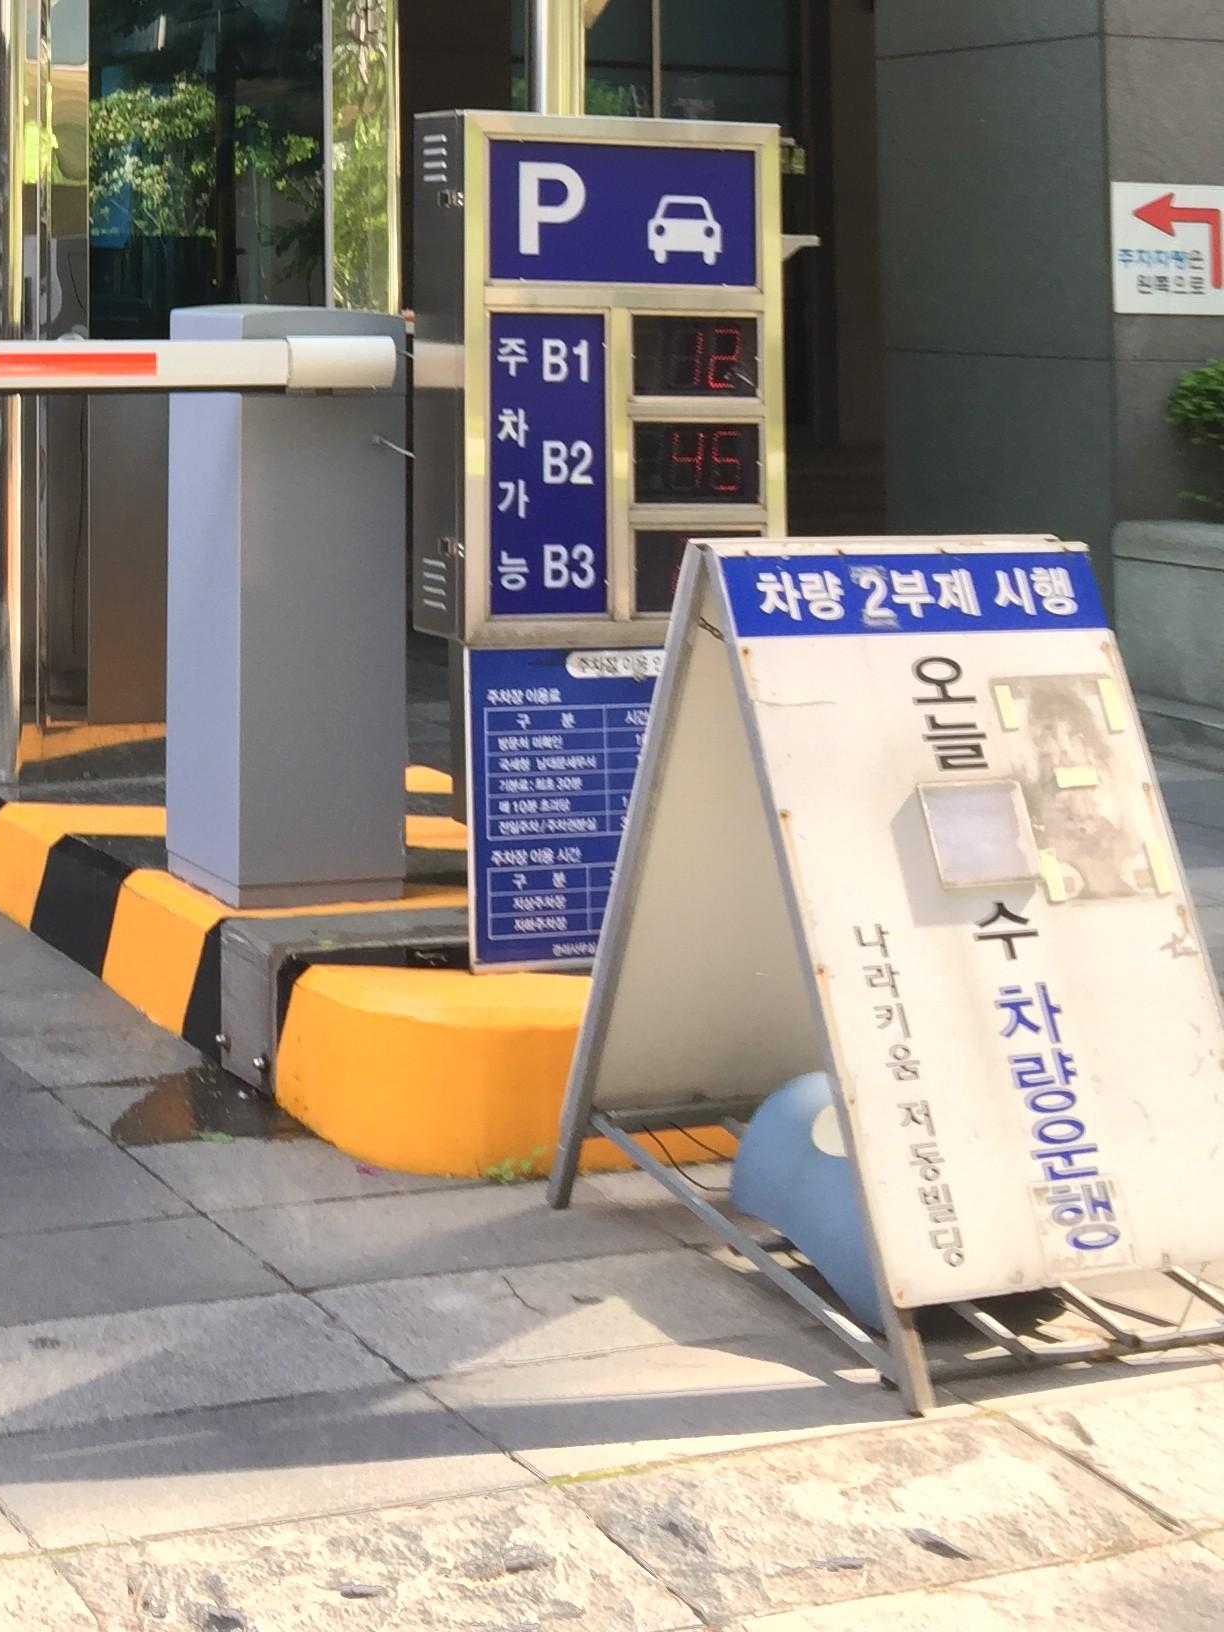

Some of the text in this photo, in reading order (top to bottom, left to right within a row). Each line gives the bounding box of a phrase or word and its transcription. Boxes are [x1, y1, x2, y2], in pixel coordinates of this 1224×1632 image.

[518, 161, 587, 256] P
[542, 338, 591, 384] B1
[692, 328, 742, 389] 12
[542, 439, 594, 486] B2
[671, 430, 743, 491] 45
[542, 543, 595, 589] B3
[755, 566, 1079, 622] 차량 2부제 시행
[911, 655, 990, 772] 오늘
[853, 923, 922, 1082] 나라키움
